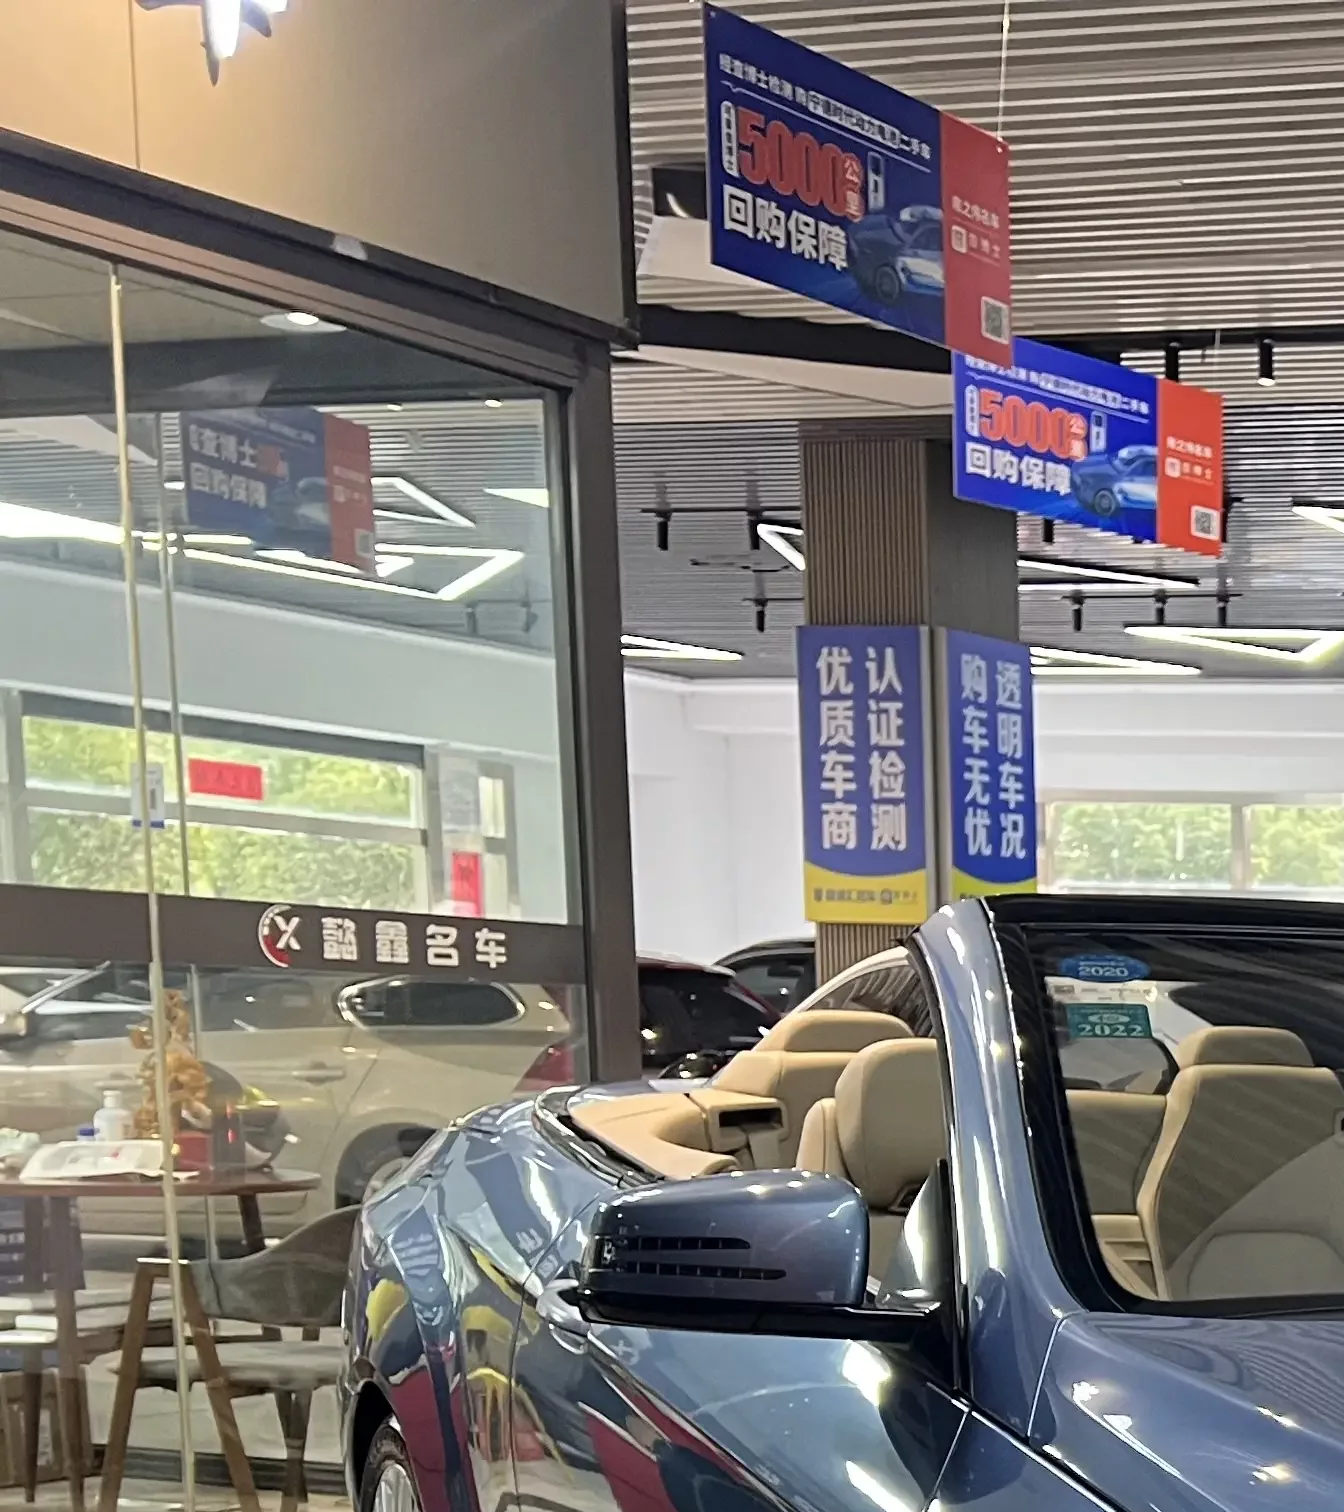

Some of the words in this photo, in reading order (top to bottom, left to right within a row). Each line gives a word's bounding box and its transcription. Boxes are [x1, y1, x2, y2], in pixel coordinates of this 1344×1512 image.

[723, 184, 849, 272] 回购保障
[965, 442, 1072, 496] 回购保障
[816, 645, 858, 851] 优质车商
[865, 645, 907, 852] 认证检测
[960, 653, 993, 857] 购车无忧
[995, 660, 1027, 860] 透明车况
[321, 916, 508, 969] 懿鑫名车
[1078, 966, 1129, 977] 2020
[1077, 1024, 1145, 1037] 2022
